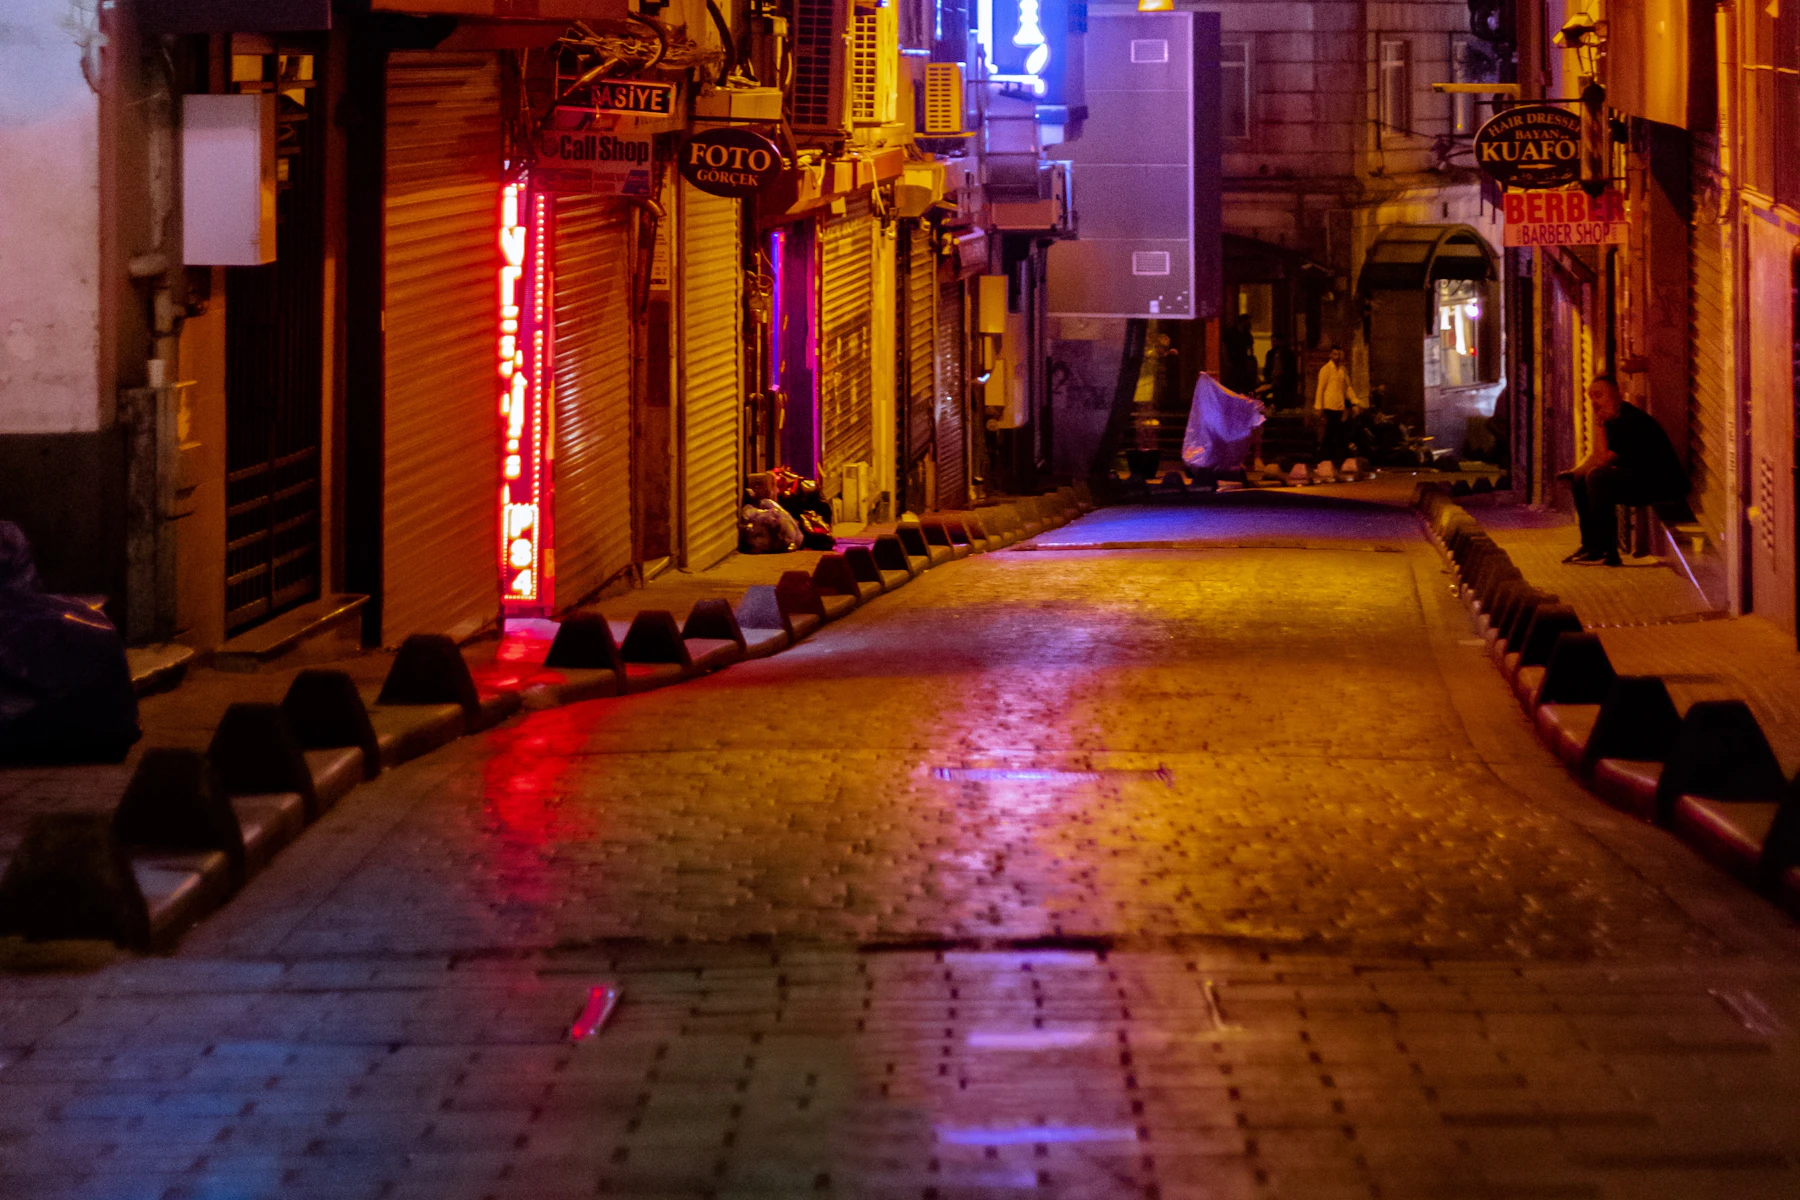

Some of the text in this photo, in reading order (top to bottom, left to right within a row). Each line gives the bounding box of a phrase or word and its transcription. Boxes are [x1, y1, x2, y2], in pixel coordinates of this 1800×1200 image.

[1487, 115, 1524, 138] HAIR
[1515, 129, 1560, 140] BAYAN
[560, 135, 596, 161] Call
[599, 135, 649, 166] Shop
[689, 142, 771, 172] FOTO
[1505, 192, 1625, 224] BERBER
[1522, 224, 1573, 245] BARBER
[1576, 222, 1611, 244] SHOP
